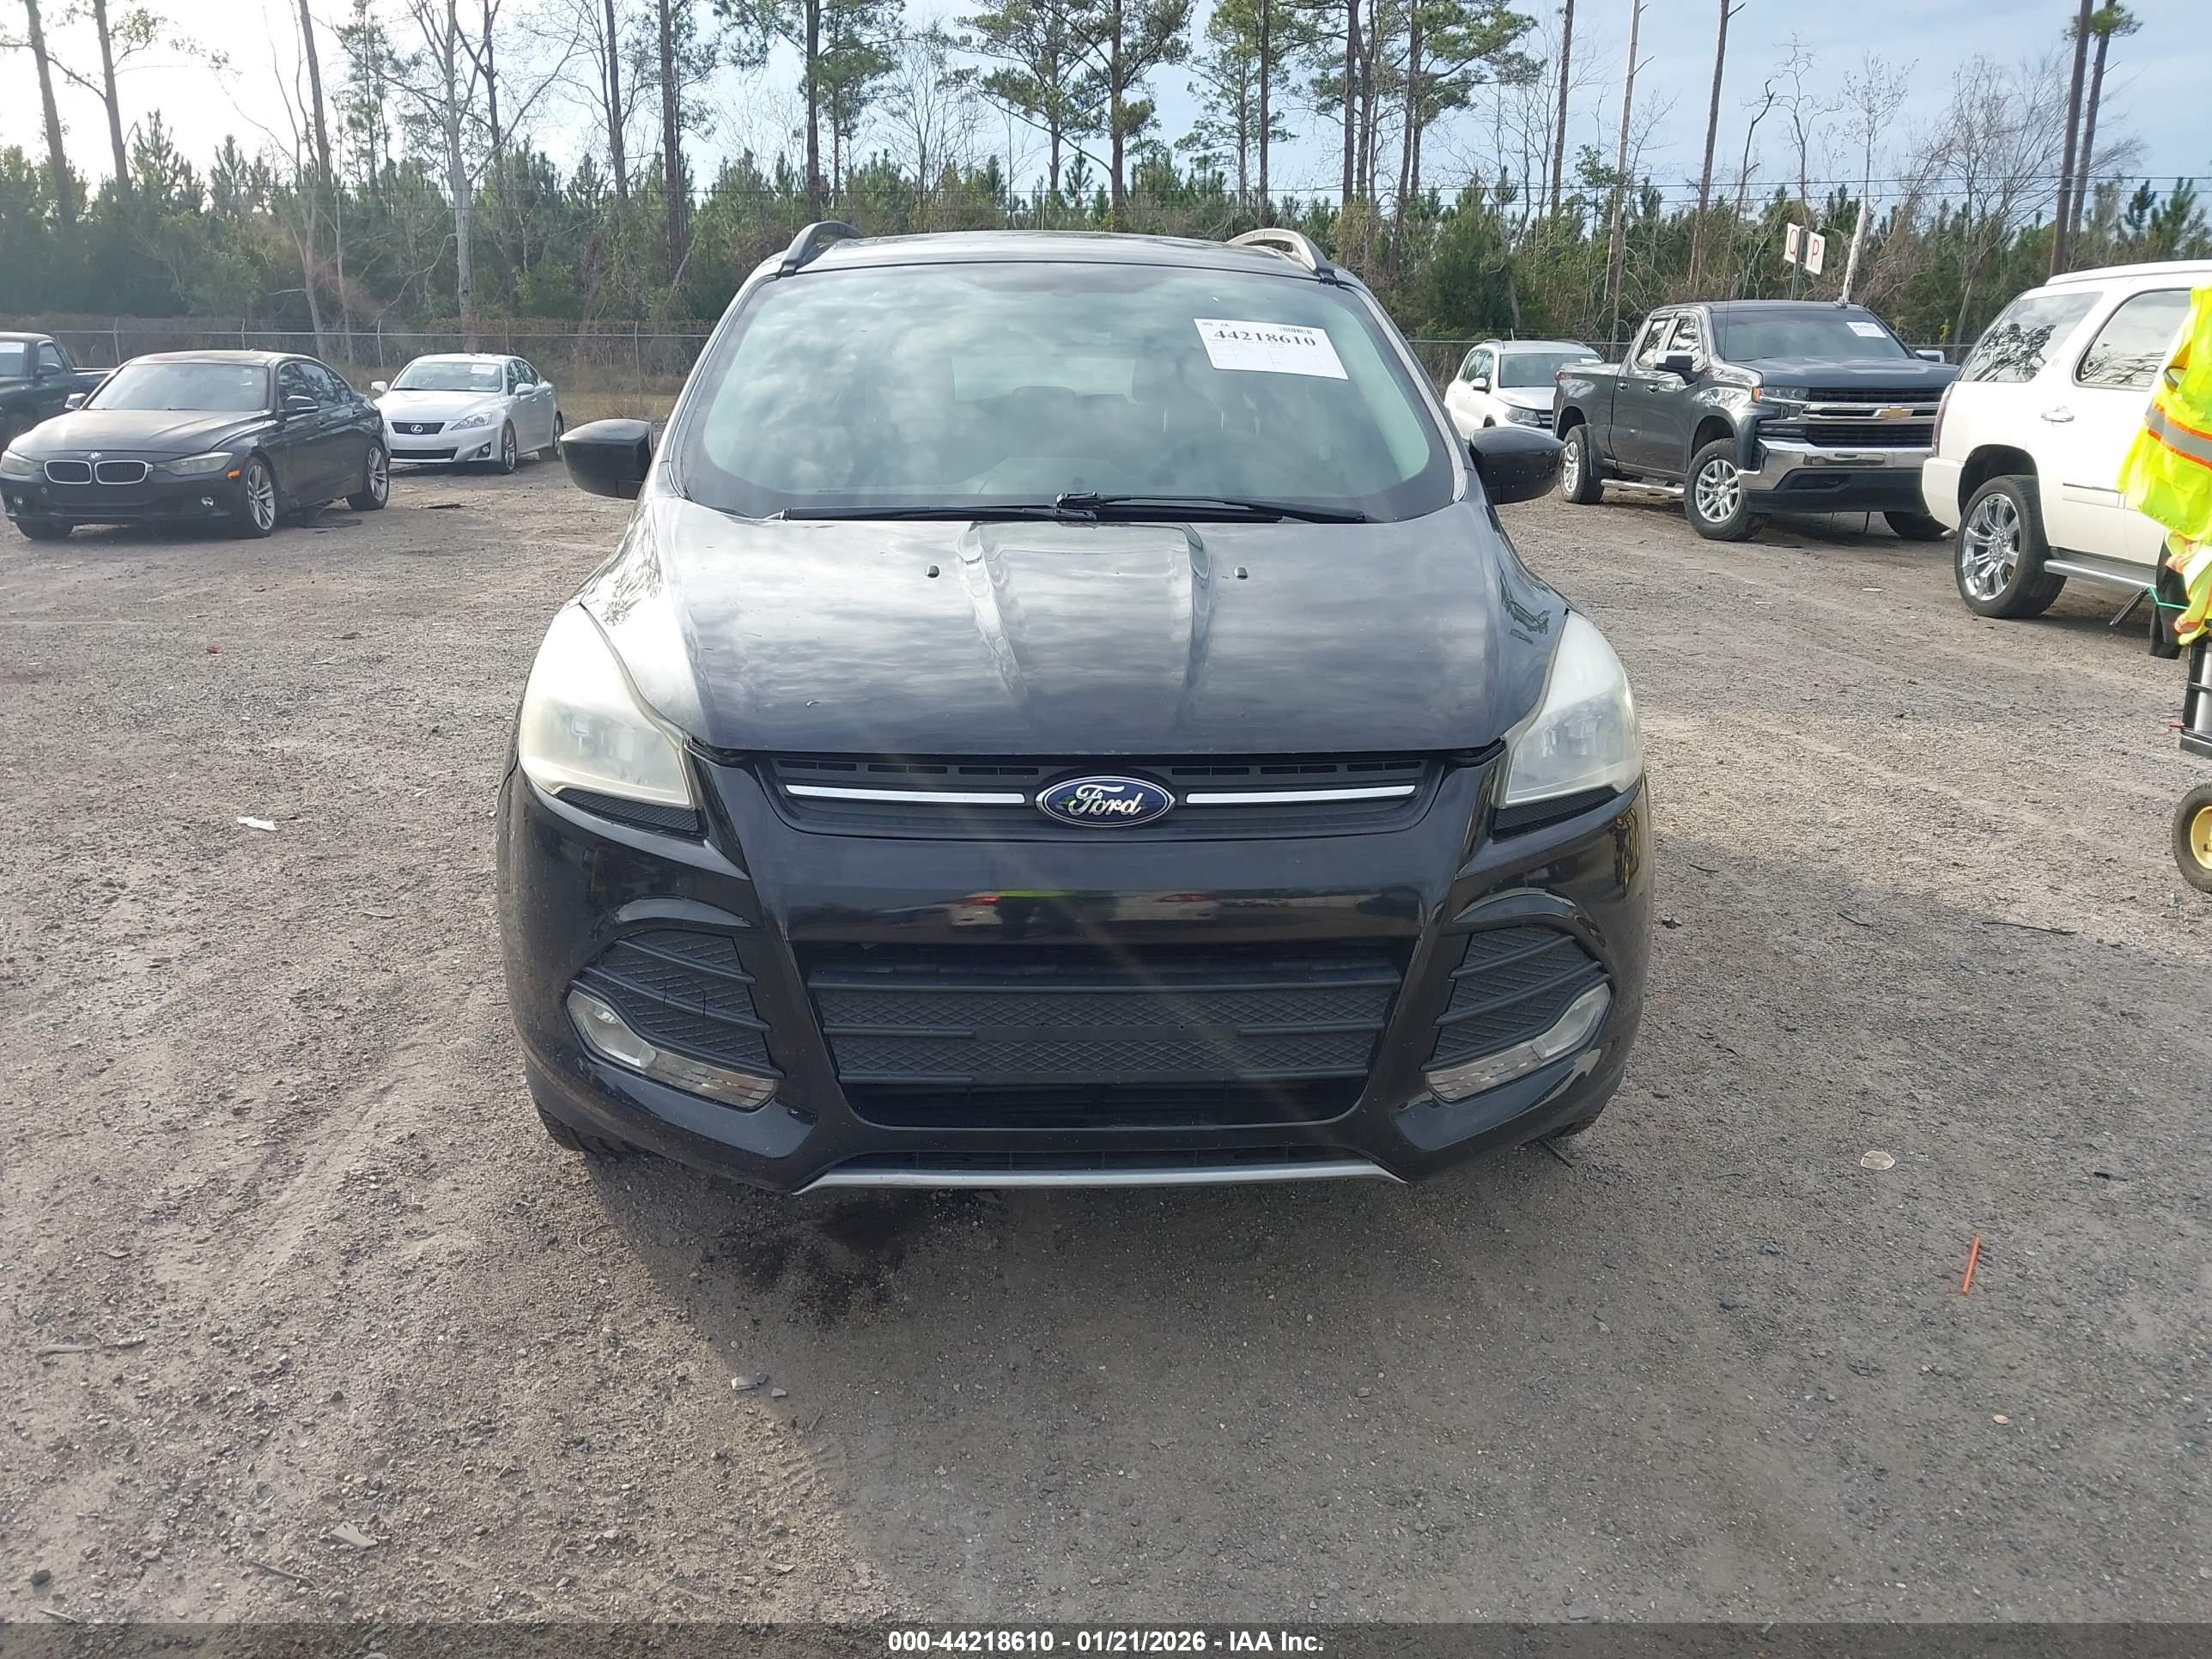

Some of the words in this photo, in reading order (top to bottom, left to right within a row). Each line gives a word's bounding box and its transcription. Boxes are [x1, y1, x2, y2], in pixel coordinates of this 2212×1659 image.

[1810, 238, 1820, 266] P
[1213, 329, 1317, 347] 44218610
[1067, 783, 1144, 816] Ford
